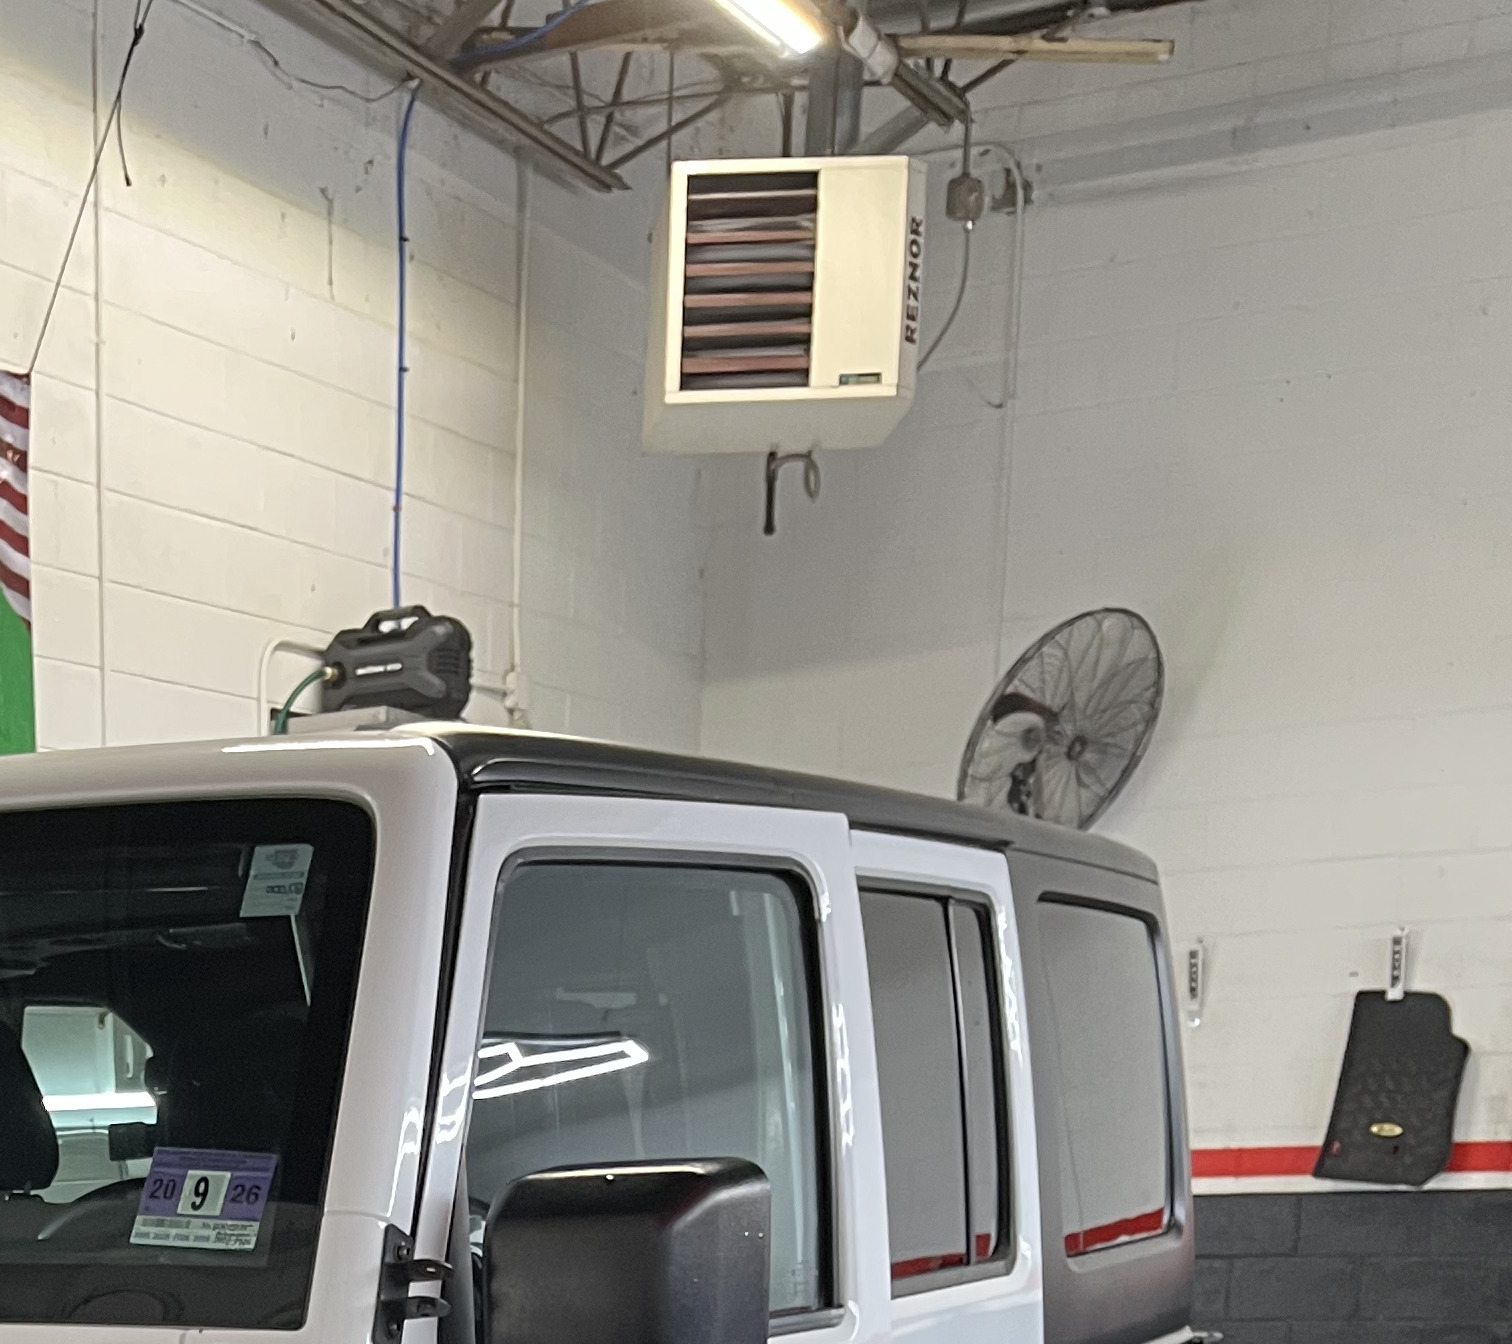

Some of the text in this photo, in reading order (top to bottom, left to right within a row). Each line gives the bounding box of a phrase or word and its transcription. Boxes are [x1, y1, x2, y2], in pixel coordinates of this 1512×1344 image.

[904, 216, 924, 345] REZNOR
[149, 1175, 262, 1212] 20 9 26
